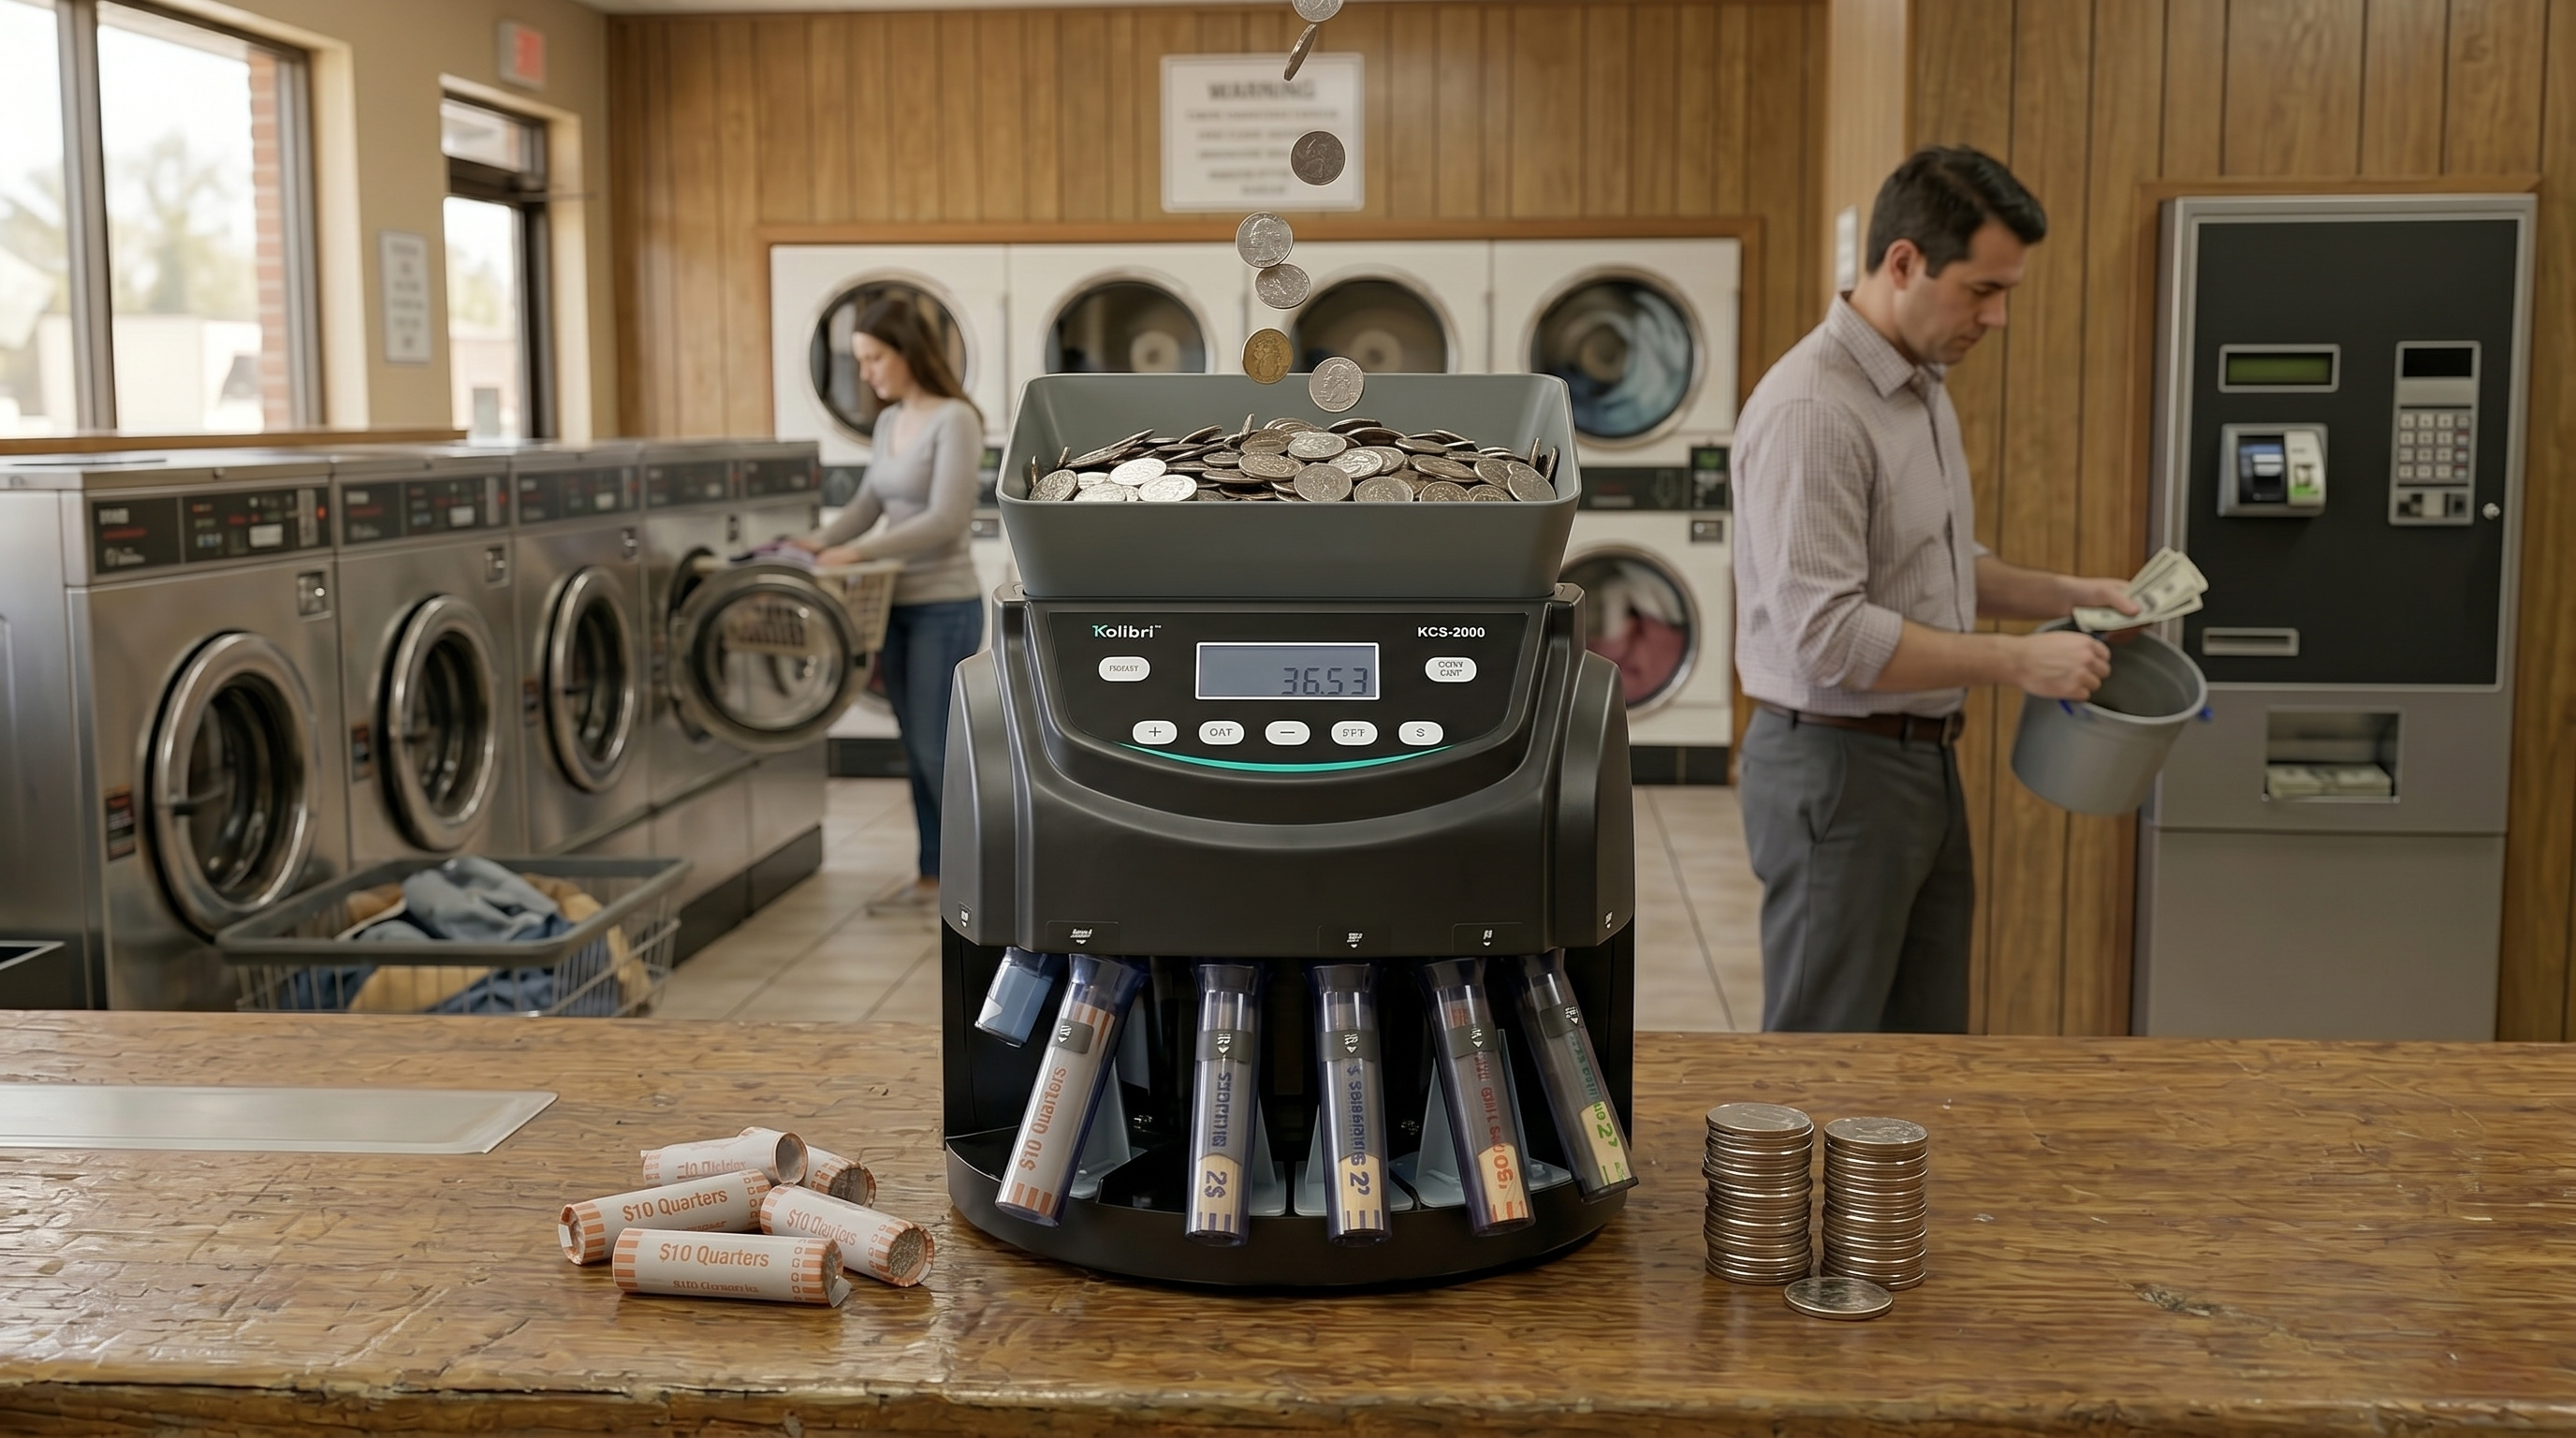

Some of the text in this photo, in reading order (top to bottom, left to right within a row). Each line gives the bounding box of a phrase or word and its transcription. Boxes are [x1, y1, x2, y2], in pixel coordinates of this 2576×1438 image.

[1417, 626, 1486, 638] KCS-2000
[1281, 667, 1368, 695] 36.53
[622, 1201, 654, 1222] $10
[658, 1190, 728, 1216] Quarters
[659, 1242, 770, 1268] $10 Quarters
